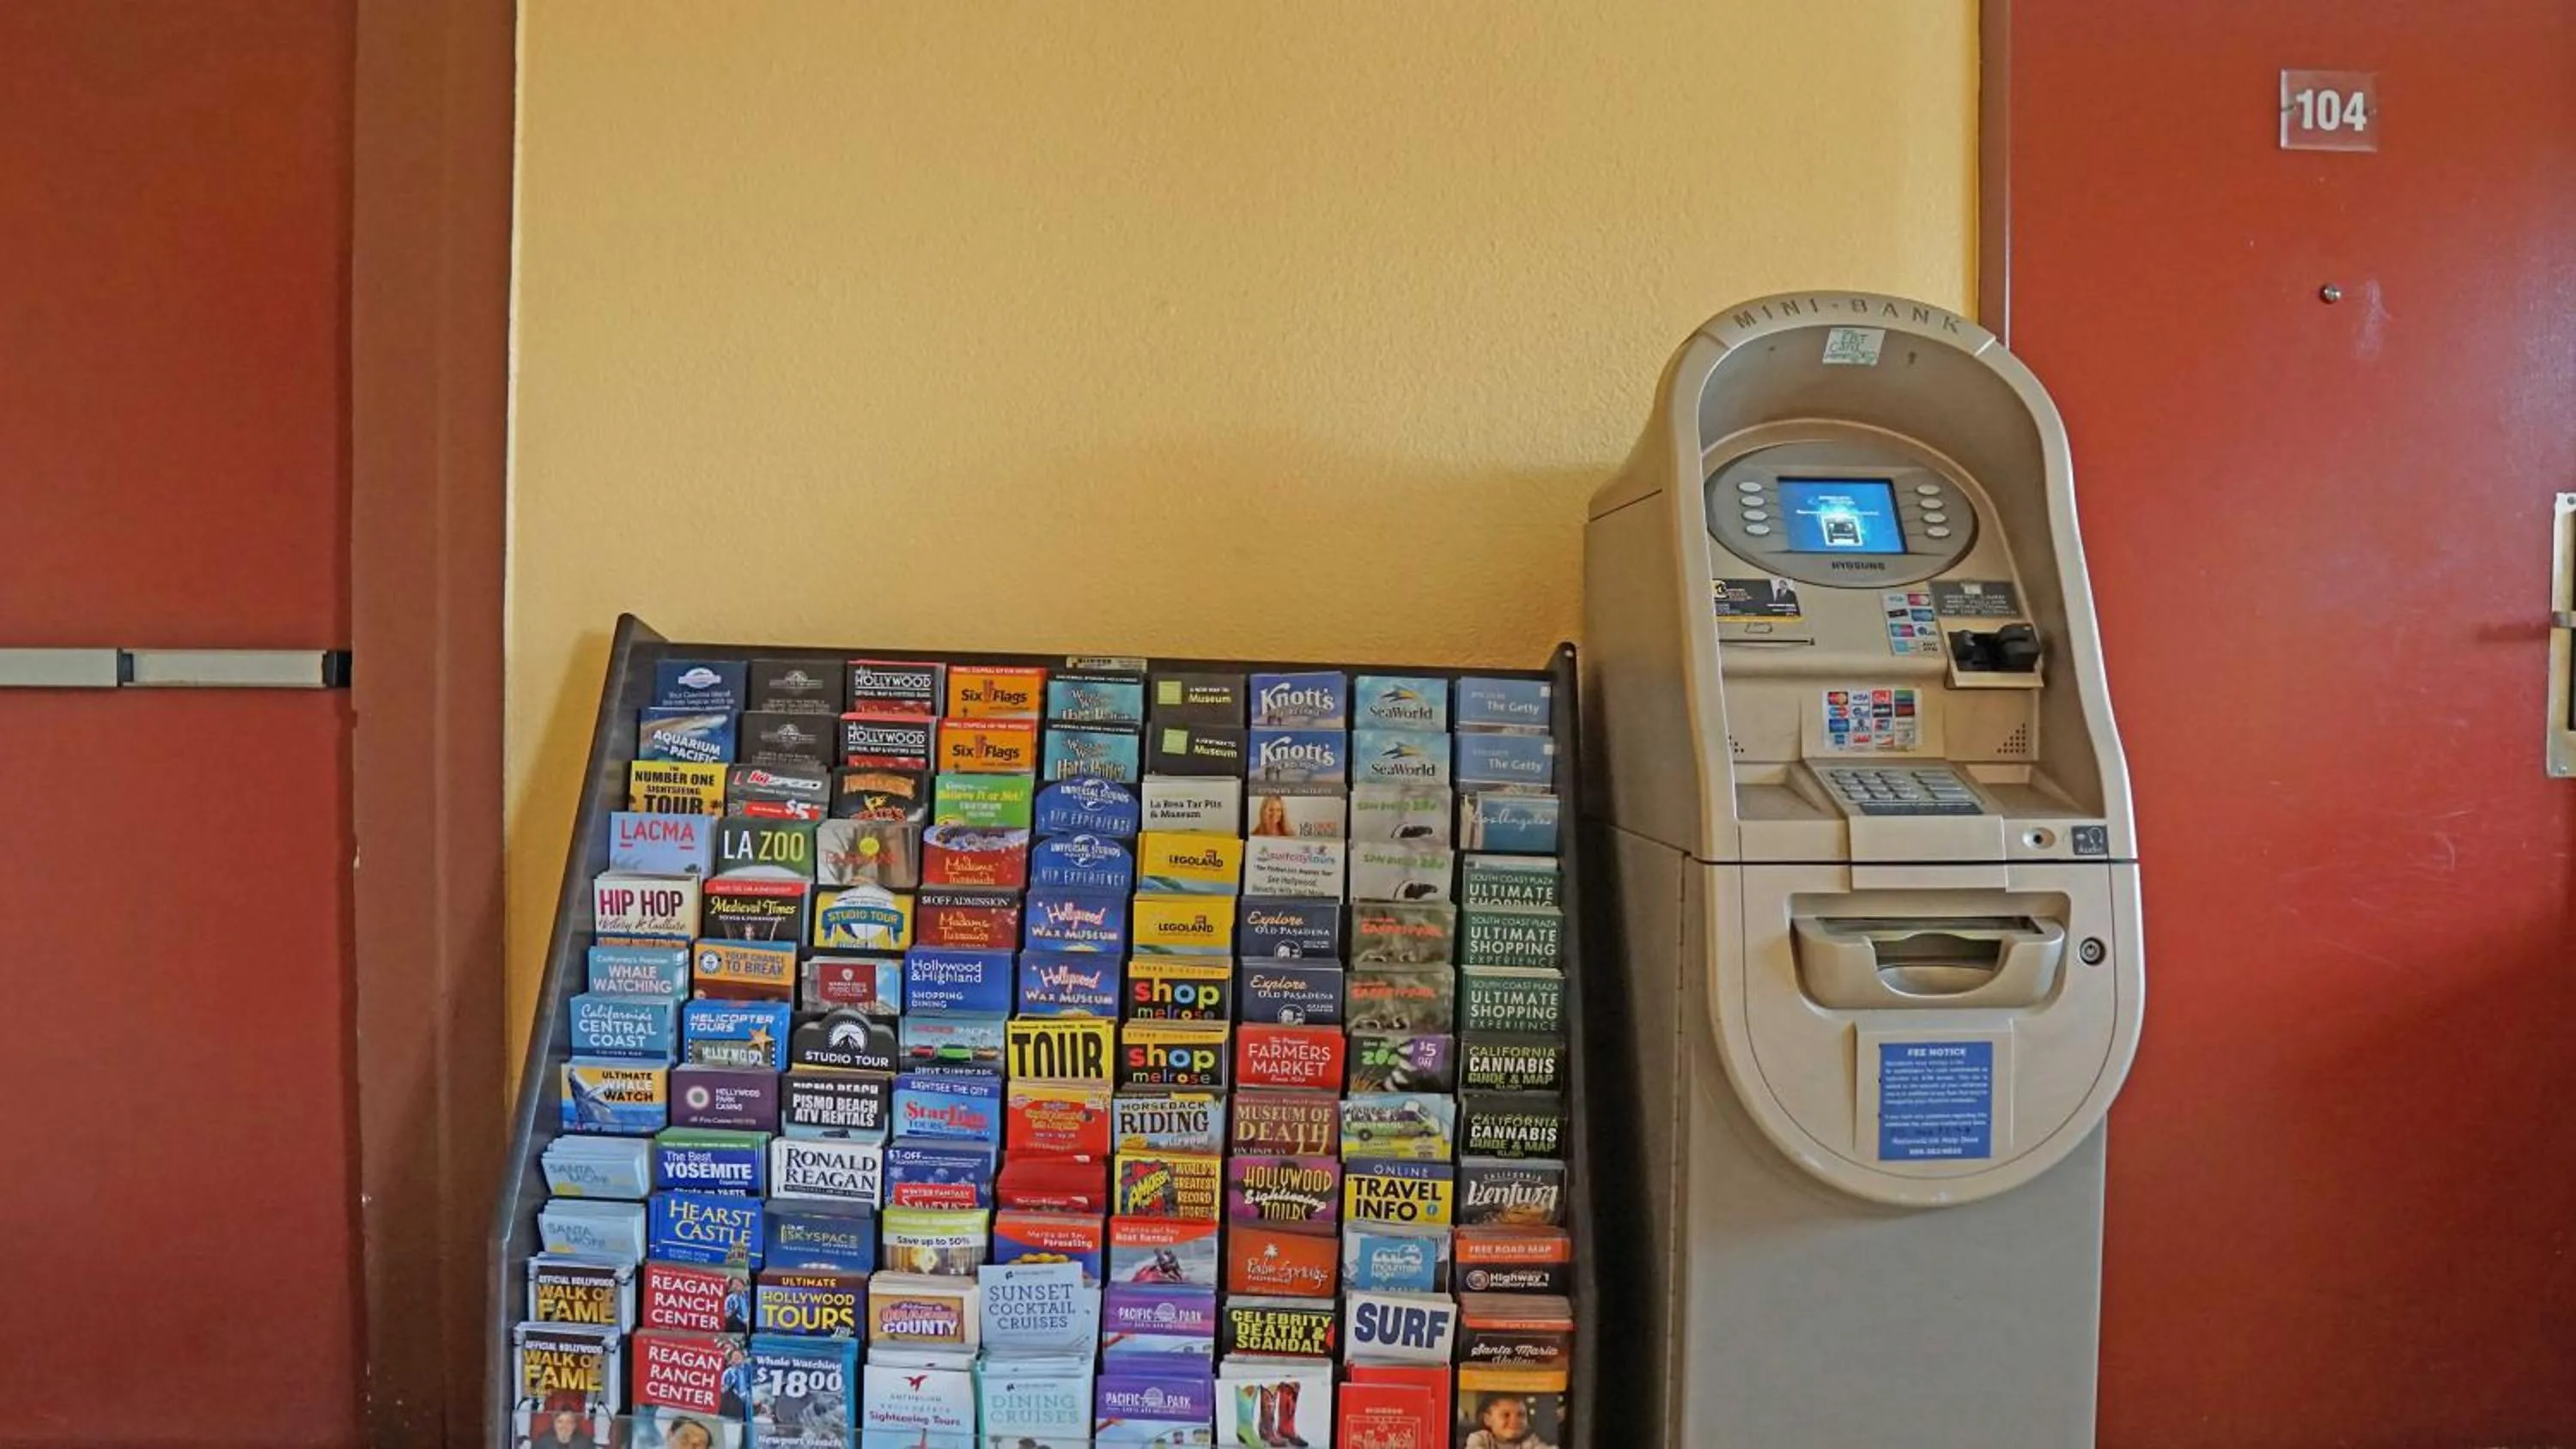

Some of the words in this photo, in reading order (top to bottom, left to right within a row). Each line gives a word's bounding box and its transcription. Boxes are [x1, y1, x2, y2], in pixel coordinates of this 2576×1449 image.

[2296, 88, 2366, 130] 104
[1732, 299, 1962, 335] MINI-BANK
[855, 676, 932, 687] HOLLYWOOD
[961, 688, 982, 701] Six
[993, 688, 1028, 705] Flags
[1188, 694, 1232, 704] Museum
[1261, 682, 1334, 715] Knott's
[1370, 706, 1433, 719] SeaWorld
[1487, 700, 1504, 712] The
[1509, 702, 1539, 715] Getty
[653, 731, 720, 756] AQUARIUM
[848, 731, 925, 743] HOLLYWOOD
[952, 745, 975, 758] Six
[986, 745, 1020, 761] Flags
[1260, 736, 1335, 767] Knott's
[1371, 763, 1436, 777] SeaWorld
[1489, 759, 1508, 770] The
[1511, 759, 1542, 773] Getty
[635, 771, 687, 785] NUMBER
[690, 773, 715, 785] ONE
[646, 785, 701, 795] SIGHTSEEING
[1071, 810, 1131, 832] EXPERIENCE
[620, 820, 695, 842] LACMA
[723, 830, 753, 859] LA
[758, 831, 805, 862] ZOO
[1169, 854, 1224, 869] LEGOLAND
[1064, 869, 1125, 886] EXPERIENCE
[1469, 883, 1553, 900] ULTIMATE
[598, 888, 634, 916] HIP
[641, 890, 683, 917] HOP
[711, 897, 760, 915] Medieval
[762, 900, 797, 915] Times
[827, 910, 867, 922] STUDIO
[871, 910, 898, 925] TOUR
[1248, 911, 1305, 926] Explore
[1158, 922, 1213, 933] LEGOLAND
[1279, 928, 1330, 937] PASADENA
[1470, 927, 1557, 942] ULTIMATE
[1469, 941, 1556, 955] SHOPPING
[911, 959, 981, 973] Hollywood
[1469, 956, 1555, 967] EXPERIENCE
[609, 966, 658, 978] WHALE
[593, 979, 671, 994] WATCHING
[1249, 974, 1307, 991] Explore
[911, 991, 963, 1000] SHOPPING
[1133, 977, 1220, 1010] shop
[1284, 991, 1334, 1000] PASADENA
[1470, 990, 1558, 1006] ULTIMATE
[911, 999, 947, 1009] DINING
[689, 1013, 775, 1024] HELICOPTER
[1469, 1005, 1558, 1019] SHOPPING
[579, 1020, 657, 1035] CENTRAL
[689, 1022, 735, 1033] TOURS
[1469, 1021, 1556, 1031] EXPERIENCE
[589, 1034, 646, 1048] COAST
[805, 1052, 851, 1064] STUDIO
[856, 1055, 889, 1067] TOUR
[1011, 1032, 1103, 1078] TOUR
[1127, 1042, 1216, 1073] shop
[1249, 1043, 1332, 1061] FARMERS
[1469, 1046, 1556, 1058] CALIFORNIA
[1907, 1048, 1926, 1057] FEE
[1252, 1062, 1326, 1076] MARKET
[1469, 1058, 1555, 1074] CANNABIS
[602, 1070, 653, 1080] ULTIMATE
[1133, 1070, 1211, 1085] melrose
[602, 1082, 653, 1091] WHALE
[715, 1088, 760, 1098] HOLLYWOOD
[910, 1081, 951, 1093] SIGHTSEE
[953, 1084, 969, 1094] THE
[969, 1086, 989, 1096] CITY
[604, 1091, 653, 1102] WATCH
[793, 1094, 834, 1109] PISMO
[836, 1096, 878, 1114] BEACH
[1121, 1102, 1206, 1112] HORSEBACK
[1236, 1105, 1306, 1121] MUSEUM
[1310, 1107, 1332, 1122] OF
[795, 1108, 818, 1122] ATV
[821, 1110, 875, 1126] RENTALS
[1120, 1112, 1210, 1133] RIDING
[1471, 1113, 1558, 1128] CALIFORNIA
[1237, 1121, 1330, 1155] DEATH
[1471, 1127, 1557, 1141] CANNABIS
[665, 1150, 686, 1161] The
[688, 1151, 712, 1161] Best
[787, 1148, 877, 1172] RONALD
[664, 1162, 753, 1179] YOSEMITE
[1373, 1164, 1428, 1178] ONLINE
[785, 1170, 877, 1190] REAGAN
[1174, 1177, 1216, 1189] GREATEST
[1243, 1166, 1333, 1192] HOLLYWOOD
[1177, 1191, 1212, 1203] RECORD
[1352, 1177, 1443, 1202] TRAVEL
[669, 1200, 756, 1228] HEARST
[1355, 1199, 1418, 1221] INFO
[675, 1221, 752, 1246] CASTLE
[896, 1235, 919, 1245] Save
[921, 1237, 934, 1246] up
[1043, 1239, 1093, 1248] Parasailing
[1495, 1246, 1525, 1254] ROAD
[1527, 1246, 1552, 1254] MAP
[538, 1275, 570, 1284] OFFICIAL
[571, 1276, 615, 1287] HOLLYWOOD
[652, 1275, 724, 1297] REAGAN
[781, 1276, 837, 1287] ULTIMATE
[538, 1285, 587, 1300] WALK
[762, 1292, 855, 1305] HOLLYWOOD
[989, 1284, 1074, 1301] SUNSET
[654, 1294, 720, 1313] RANCH
[988, 1302, 1076, 1316] COCKTAIL
[538, 1300, 616, 1324] FAME
[652, 1309, 720, 1330] CENTER
[762, 1306, 855, 1330] TOURS
[1231, 1310, 1331, 1327] CELEBRITY
[882, 1320, 959, 1337] COUNTY
[997, 1316, 1069, 1330] CRUISES
[1354, 1302, 1450, 1349] SURF
[1238, 1322, 1301, 1339] DEATH
[1311, 1331, 1325, 1340] &
[525, 1341, 556, 1351] OFFICIAL
[559, 1342, 604, 1354] HOLLYWOOD
[1236, 1335, 1325, 1354] SCANDAL
[1470, 1343, 1513, 1357] Santa
[1516, 1343, 1558, 1356] Maria
[525, 1352, 576, 1367] WALK
[648, 1346, 722, 1371] REAGAN
[756, 1355, 791, 1367] Whale
[793, 1358, 842, 1373] Watching
[524, 1366, 604, 1392] FAME
[650, 1365, 715, 1388] RANCH
[646, 1382, 715, 1405] CENTER
[1105, 1393, 1140, 1407] PACIFIC
[1166, 1395, 1191, 1408] PARK
[991, 1394, 1076, 1410] DINING
[868, 1410, 929, 1427] Sightseeing
[933, 1416, 961, 1427] Tours
[990, 1410, 1081, 1424] CRUISES
